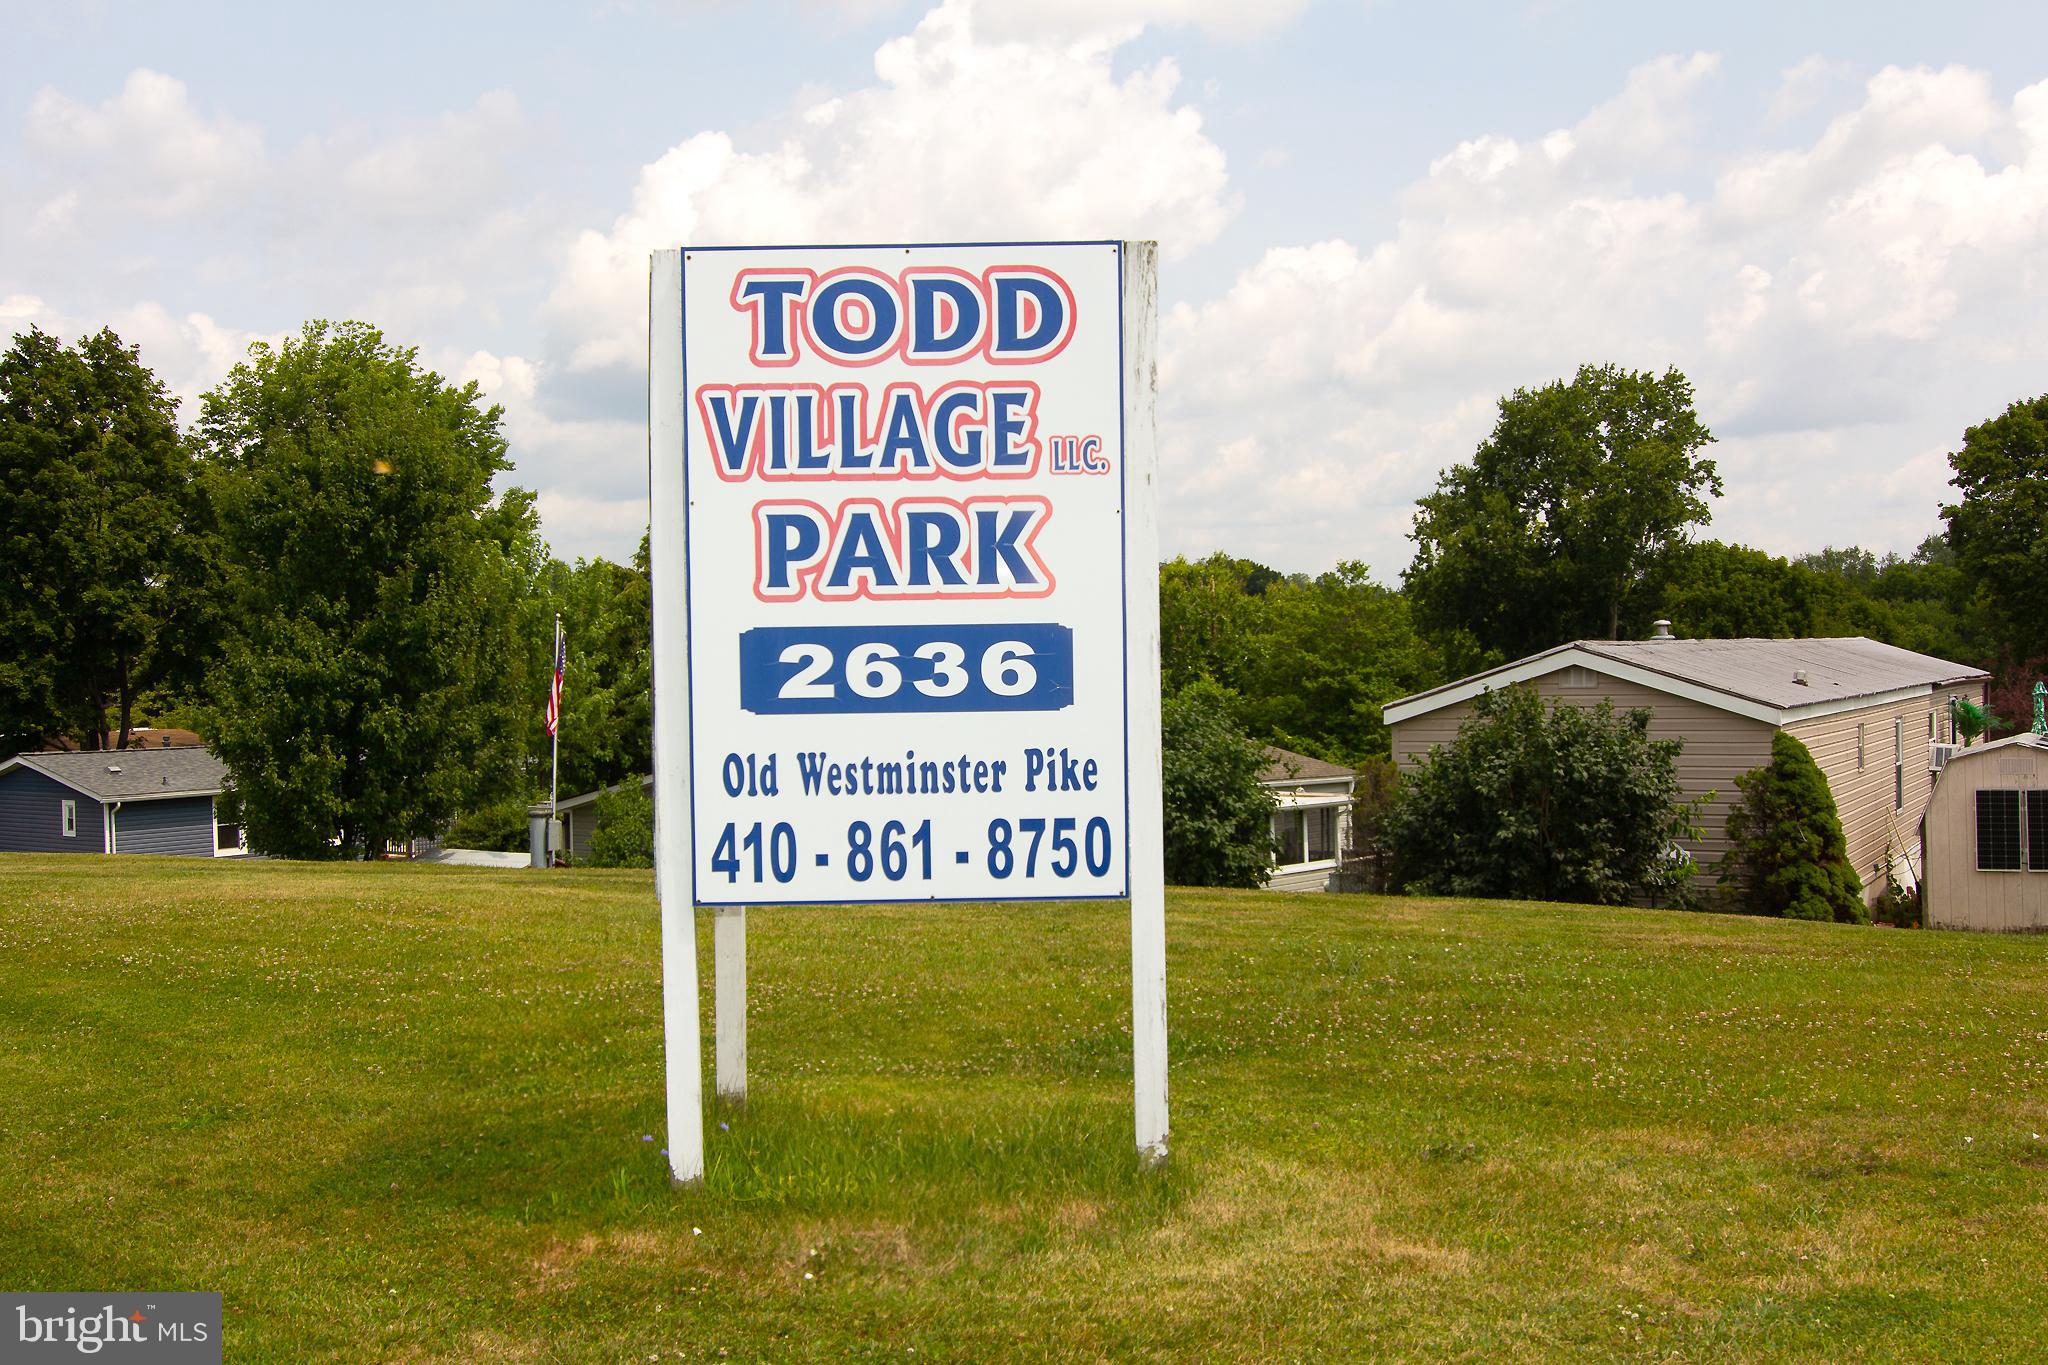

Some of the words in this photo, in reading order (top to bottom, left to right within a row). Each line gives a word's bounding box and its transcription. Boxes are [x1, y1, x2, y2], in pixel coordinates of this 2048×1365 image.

[741, 276, 1065, 356] TODD
[707, 391, 1031, 471] VILLAGE
[1051, 438, 1107, 473] LLC.
[765, 509, 1040, 589] PARK
[777, 640, 1038, 699] 2636
[722, 752, 779, 798] Old
[796, 749, 1007, 797] Westminster
[1023, 747, 1099, 792] Pike
[711, 821, 798, 884] 410
[846, 818, 932, 882] 861
[987, 816, 1112, 880] 8750
